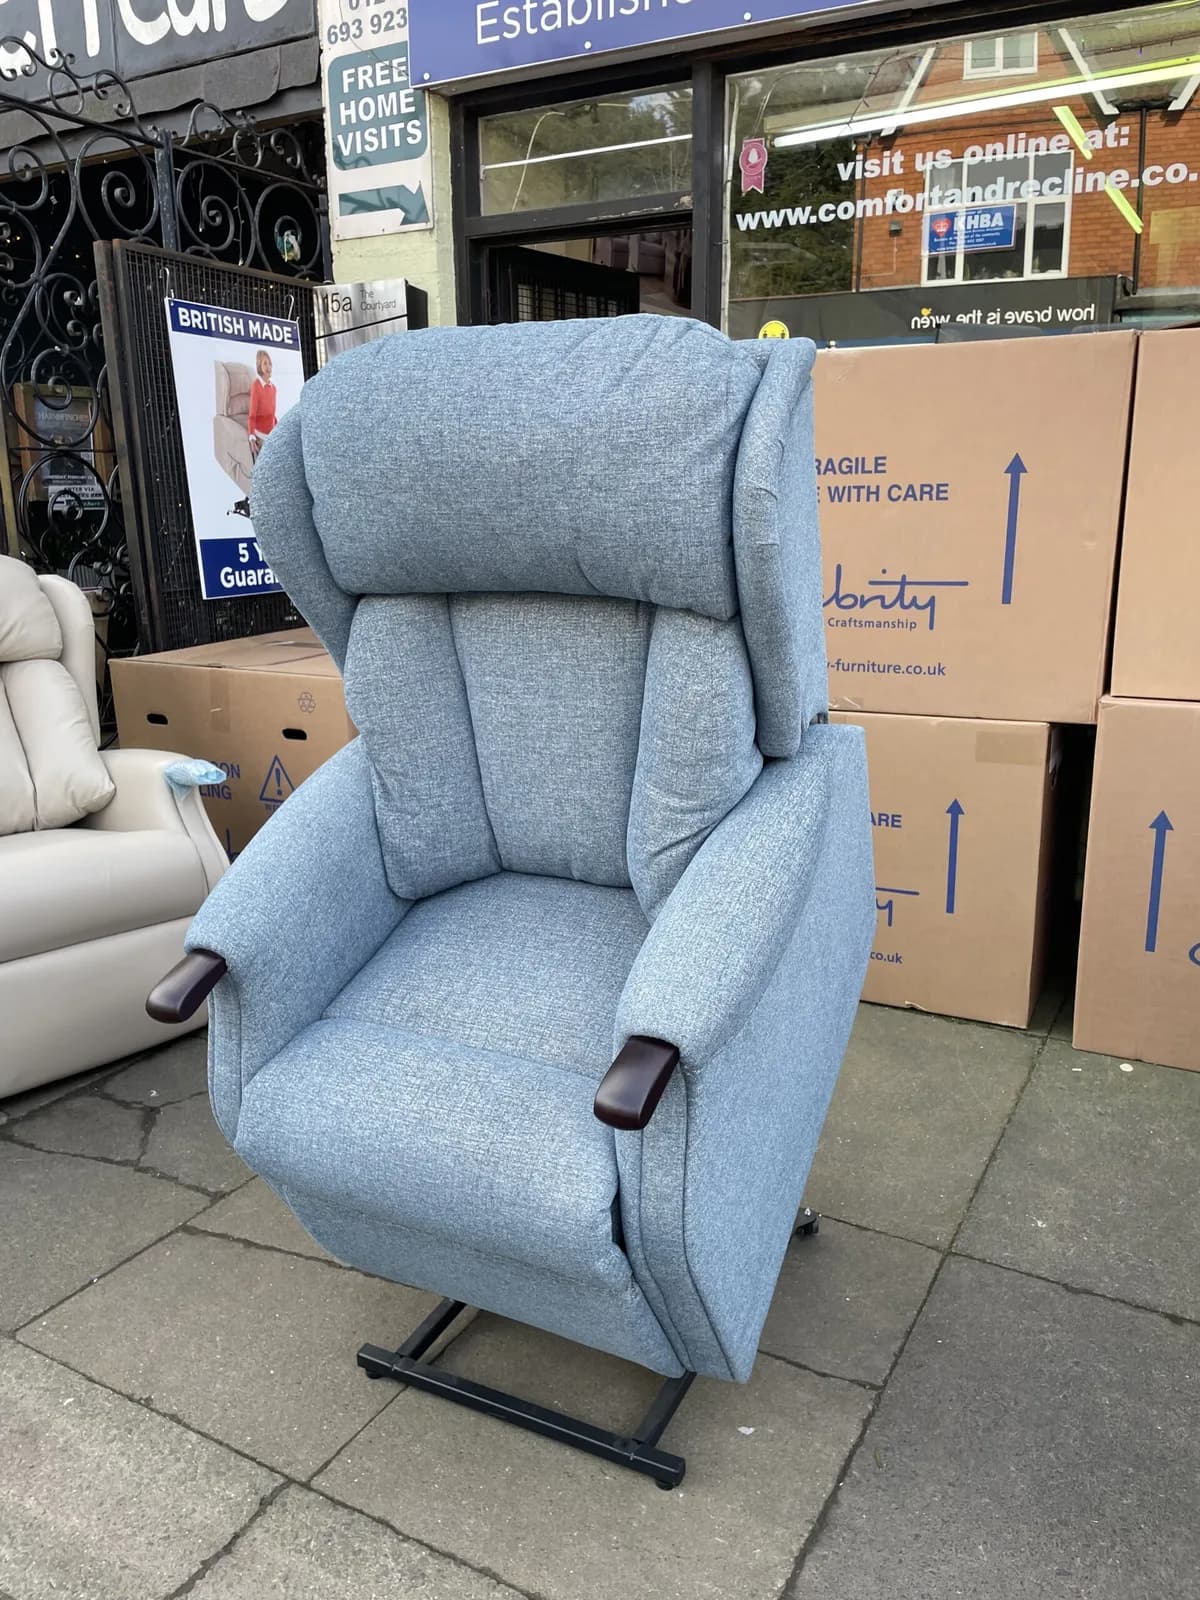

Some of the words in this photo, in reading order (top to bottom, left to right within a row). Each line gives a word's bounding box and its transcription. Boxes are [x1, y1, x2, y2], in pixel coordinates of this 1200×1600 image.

[328, 18, 363, 45] 693
[370, 7, 407, 35] 923
[476, 0, 692, 45] Estabs
[342, 56, 408, 94] FREE
[339, 88, 416, 126] HOME
[336, 119, 422, 157] VISITS
[836, 150, 904, 182] visit
[914, 149, 953, 172] us
[963, 132, 1070, 165] online
[1083, 123, 1130, 150] at:
[735, 162, 1198, 231] www.comfortandrecline.co.
[323, 293, 353, 314] 15a
[177, 307, 245, 337] BRITISH
[249, 319, 294, 344] MADE
[827, 485, 881, 503] WITH
[887, 483, 949, 502] CARE
[238, 542, 250, 563] 5
[823, 563, 969, 631] brity
[827, 617, 918, 632] Craftsmanship
[827, 658, 946, 676] -furniture.co.uk
[211, 761, 241, 778] ON
